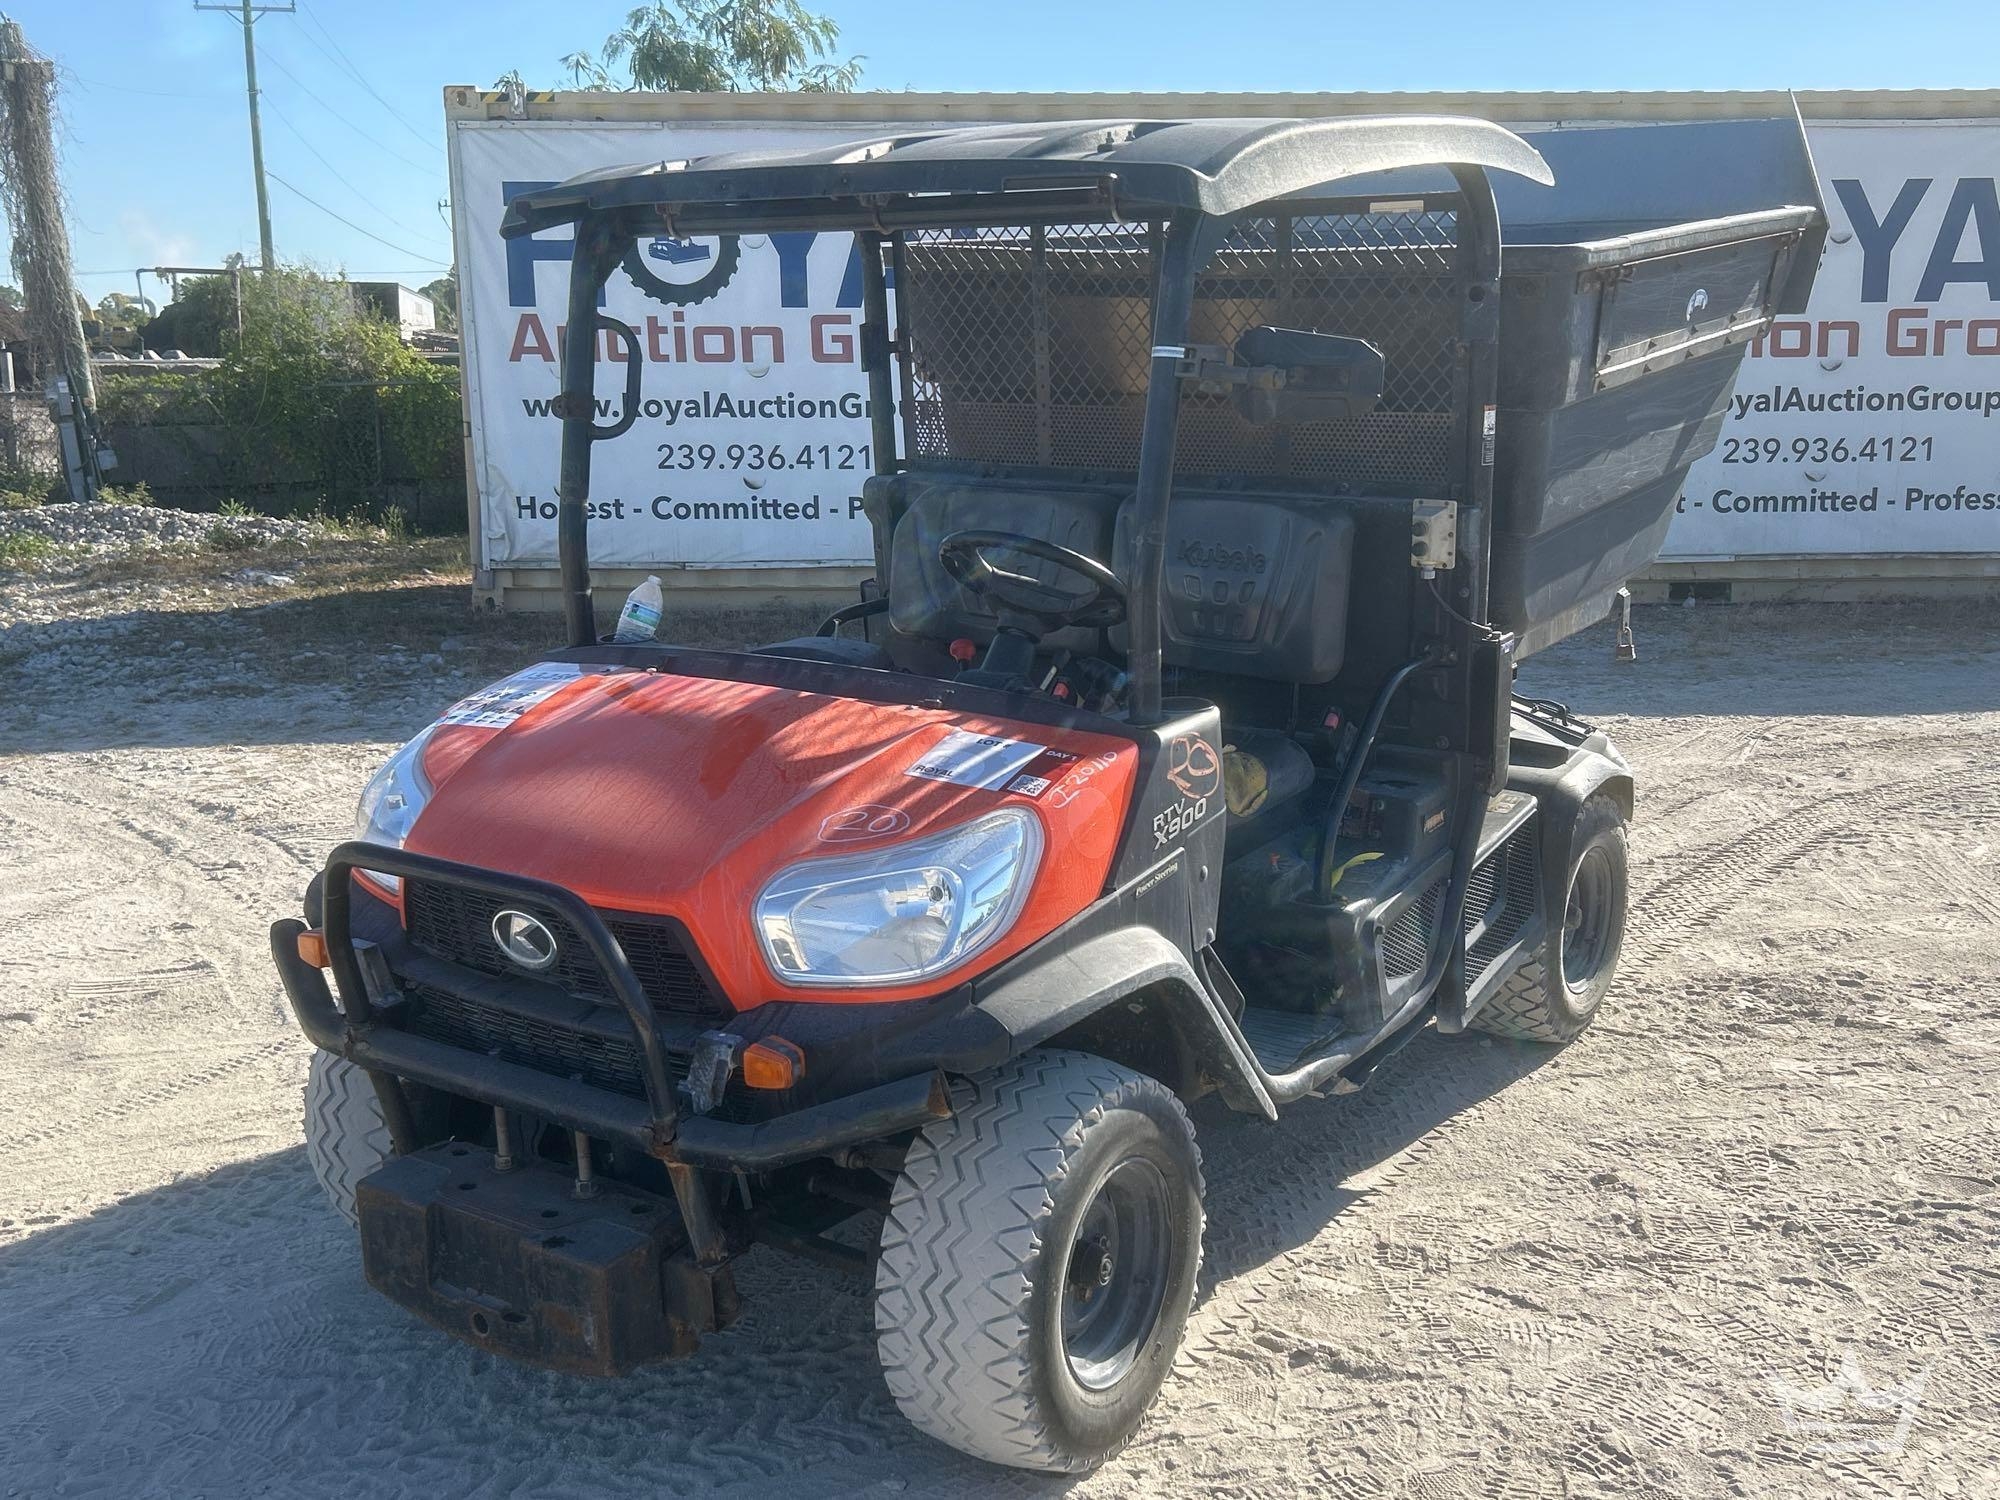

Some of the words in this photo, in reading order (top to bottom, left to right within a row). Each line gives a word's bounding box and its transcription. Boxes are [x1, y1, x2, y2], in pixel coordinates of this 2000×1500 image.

[509, 311, 785, 363] Action
[657, 444, 872, 470] 239.936.4121
[1722, 437, 1933, 464] 239.936.4121
[516, 496, 625, 520] Hoest
[651, 495, 820, 520] Committed
[1712, 488, 1878, 513] Committed
[976, 738, 1002, 747] LOT
[1046, 750, 1070, 759] DAY
[1153, 798, 1185, 831] RTV
[1154, 797, 1207, 850] X900
